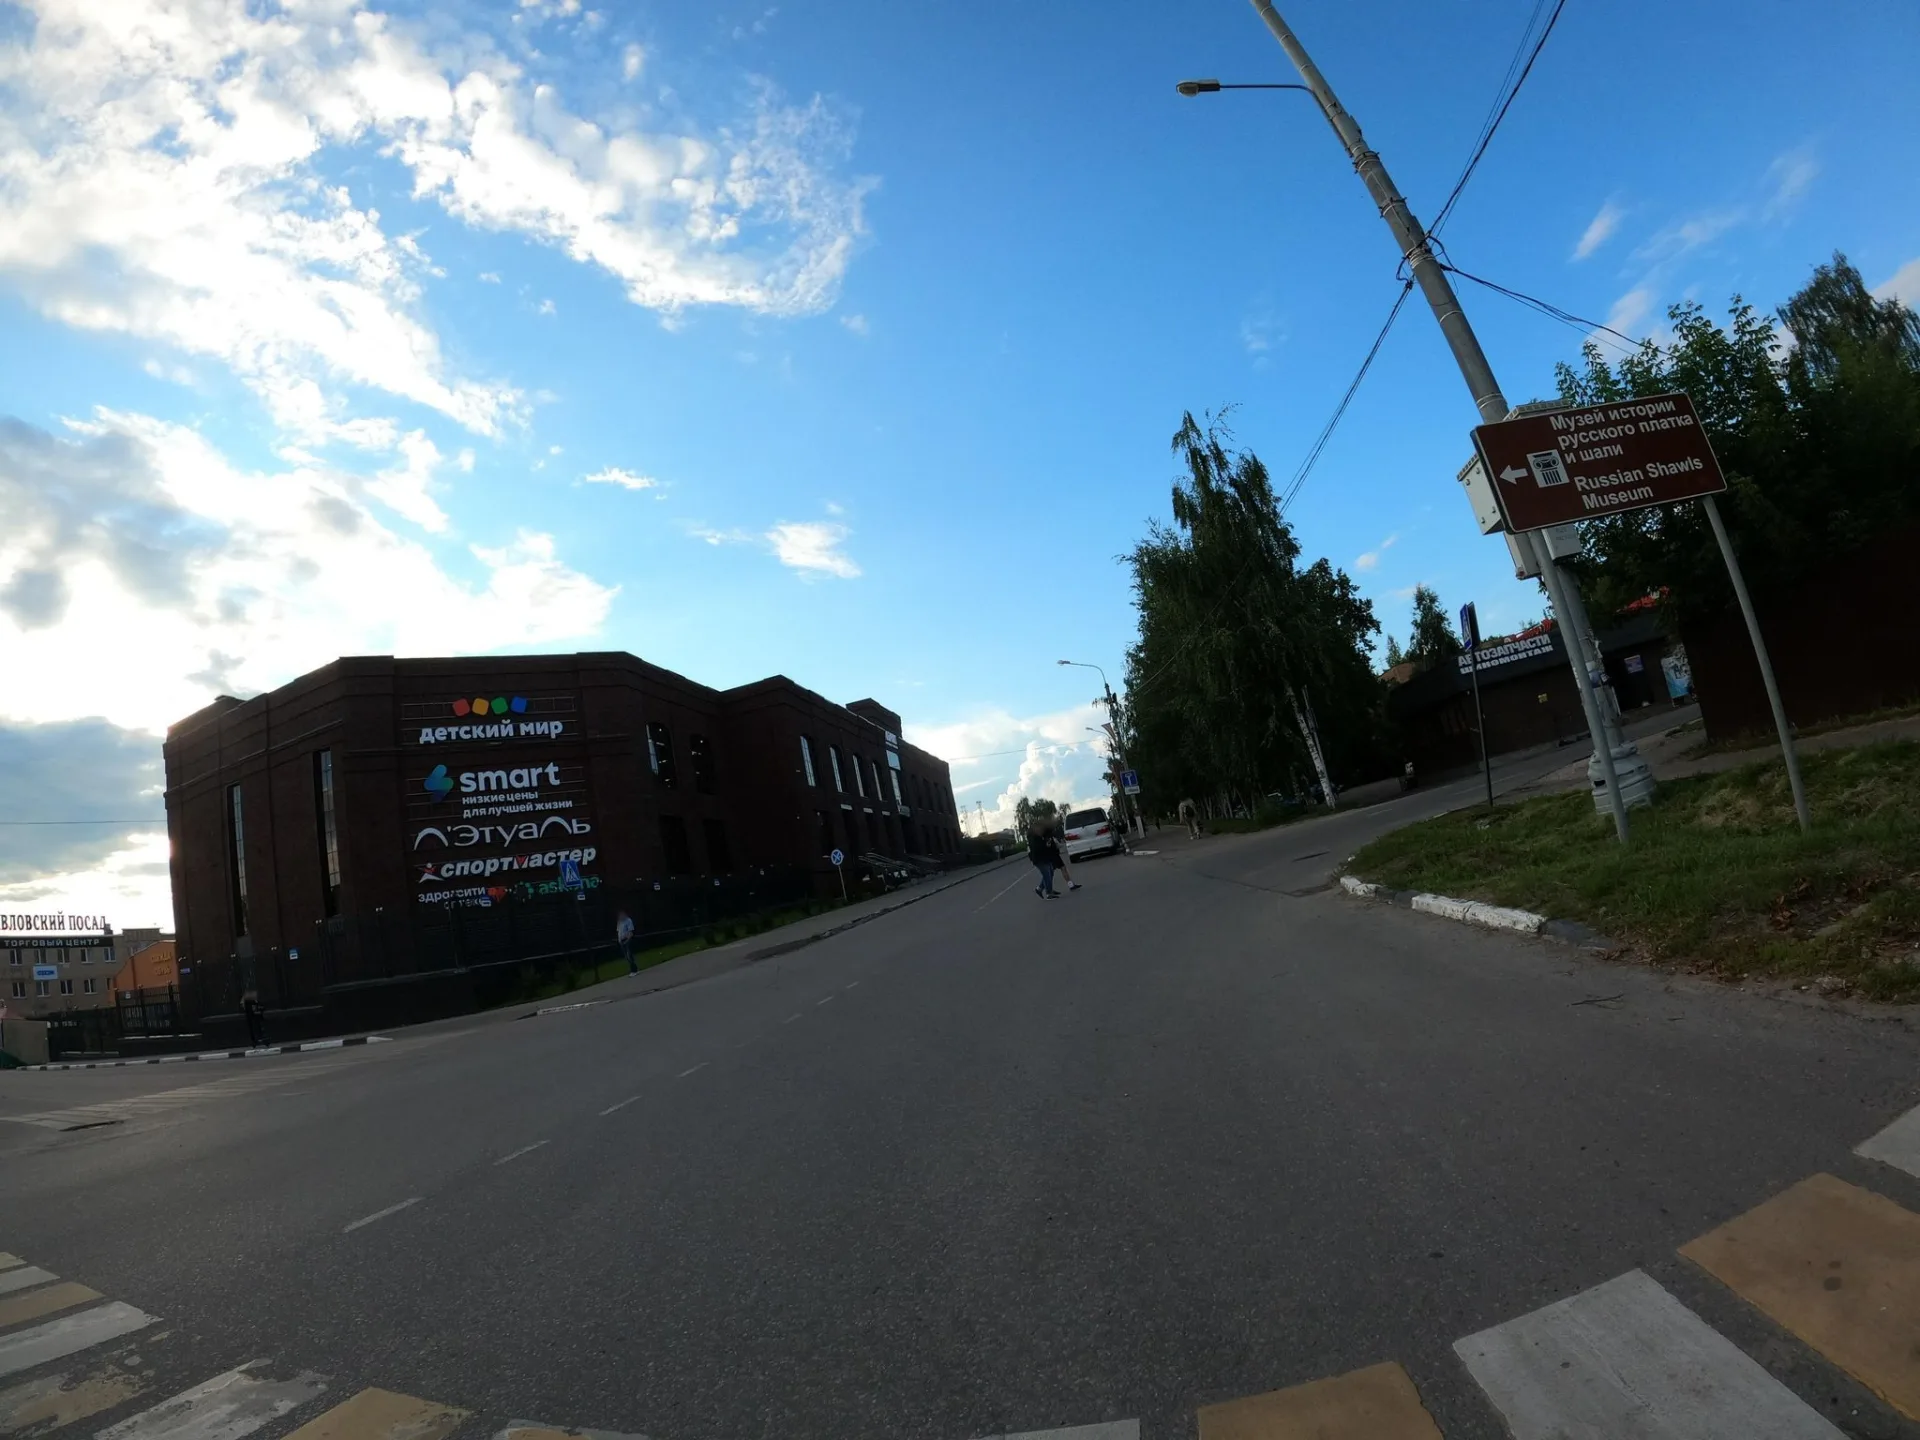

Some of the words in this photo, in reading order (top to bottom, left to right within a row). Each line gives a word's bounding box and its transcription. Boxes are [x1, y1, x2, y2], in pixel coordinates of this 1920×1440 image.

[1550, 408, 1605, 431] Музей
[1608, 400, 1676, 421] истории
[1557, 424, 1637, 450] русского
[1639, 414, 1695, 433] платка
[1564, 451, 1577, 465] и
[1579, 444, 1624, 461] шали
[1574, 469, 1645, 492] Russian
[1646, 456, 1704, 479] Shawls
[1582, 486, 1654, 510] Museum
[418, 719, 515, 744] детский
[519, 720, 564, 738] мир
[459, 761, 561, 793] smart
[461, 792, 506, 805] низкие
[506, 791, 539, 803] цены
[462, 807, 489, 819] для
[489, 802, 534, 817] лучшей
[534, 799, 573, 811] жизни
[537, 875, 600, 894] askna
[68, 915, 106, 931] ПОСАД
[4, 939, 64, 947] ТОРГОВЫЙ
[65, 938, 100, 946] ЦЕНТР
